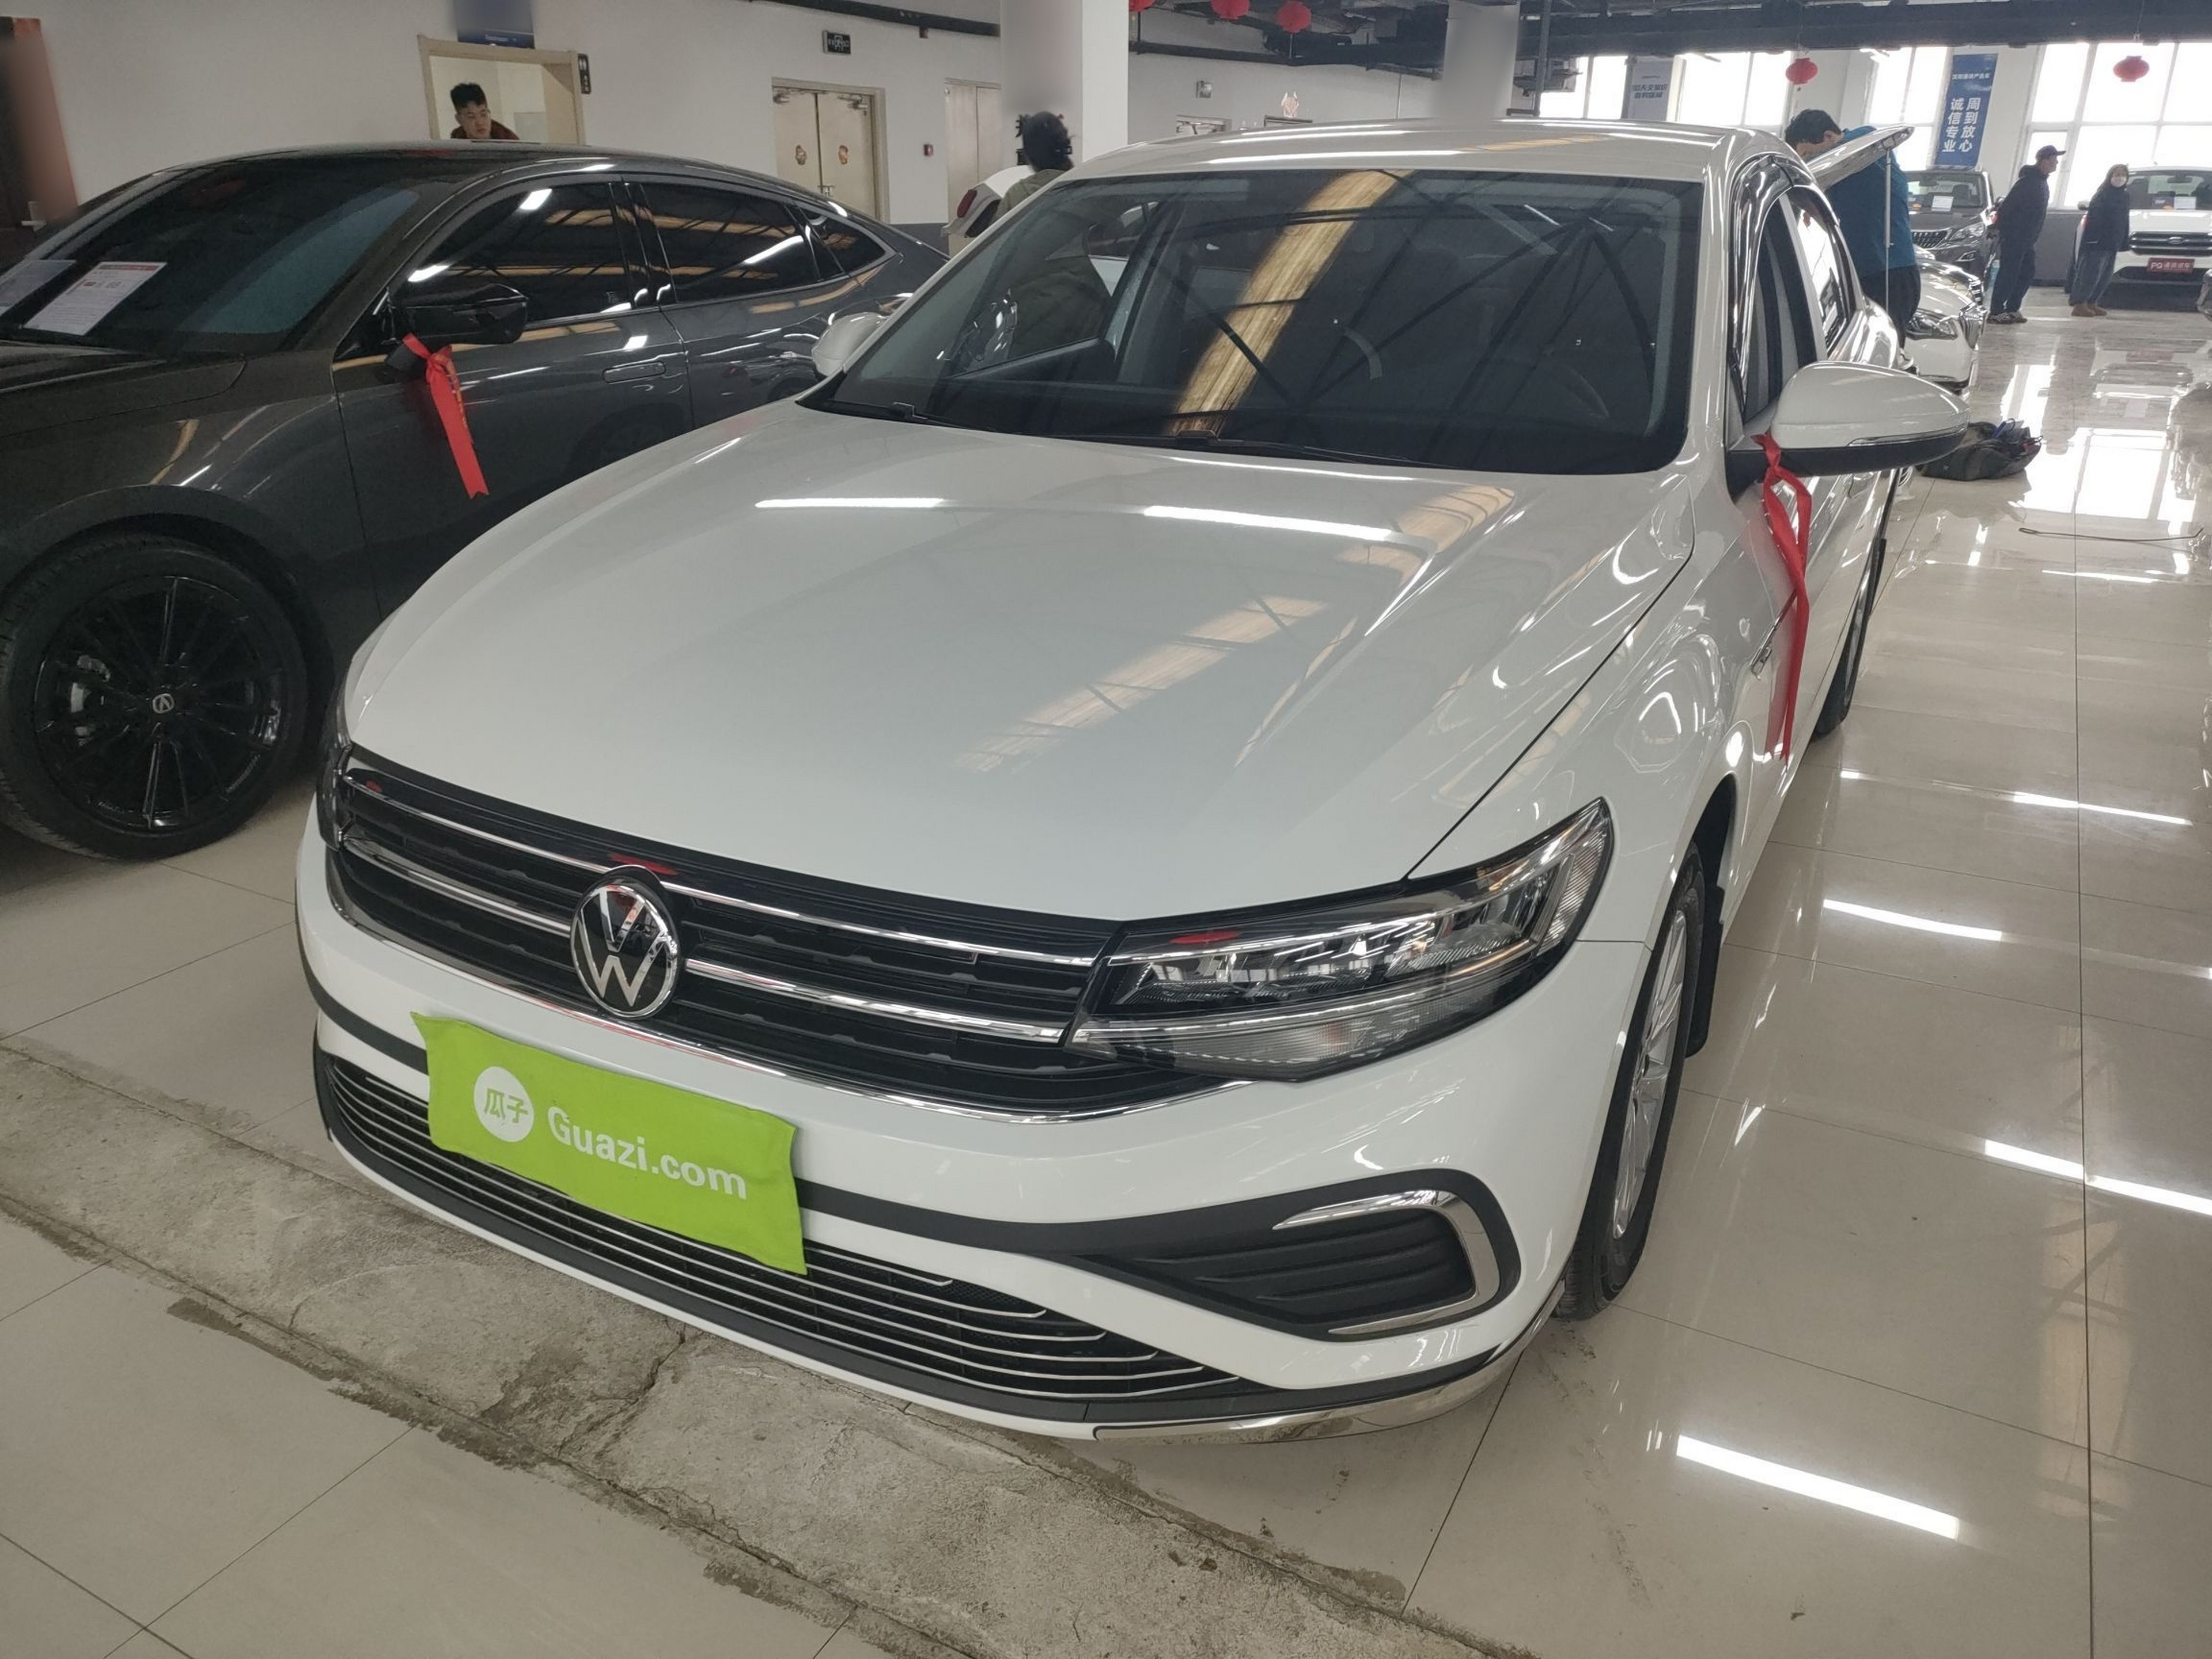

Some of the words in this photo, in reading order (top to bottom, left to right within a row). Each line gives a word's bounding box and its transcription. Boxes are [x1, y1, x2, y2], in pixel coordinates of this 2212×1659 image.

[1942, 97, 1964, 152] 诚信专业
[1959, 97, 1981, 152] 周到放心
[484, 1088, 529, 1124] 瓜子
[548, 1107, 747, 1199] Guazi.com
